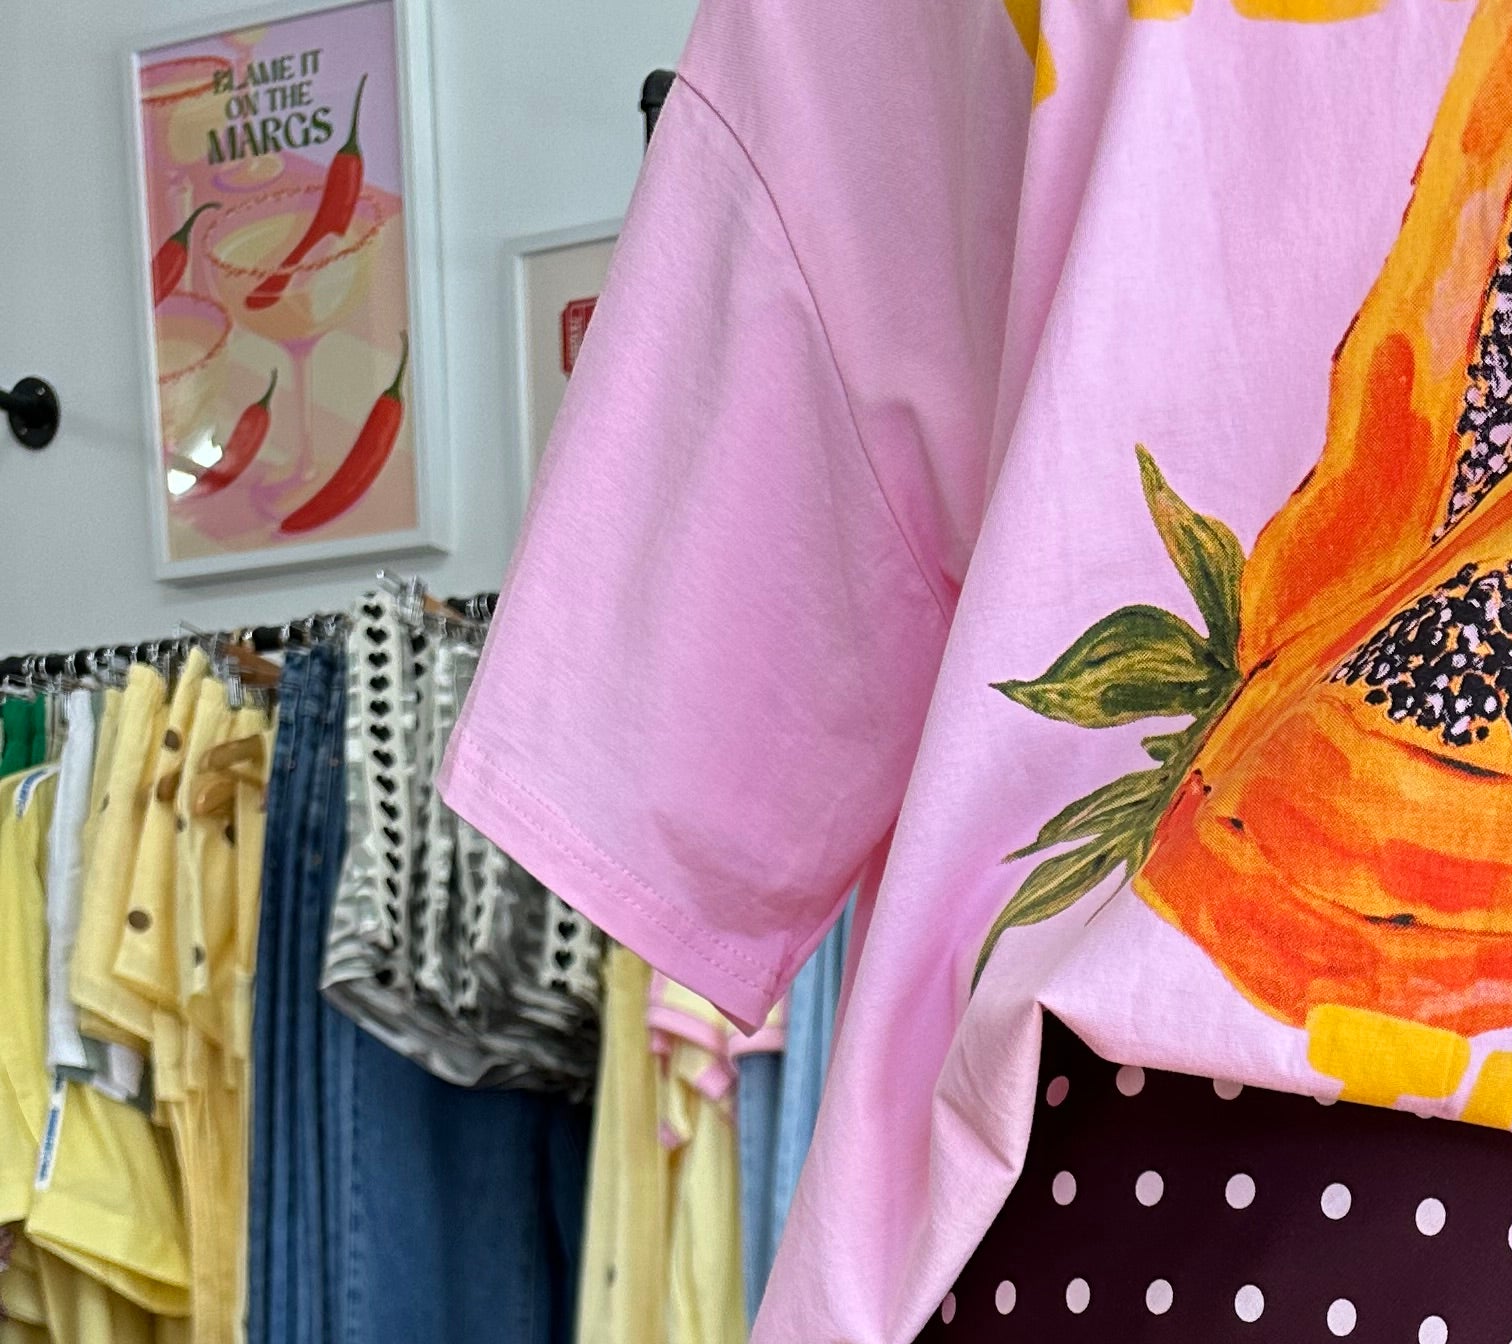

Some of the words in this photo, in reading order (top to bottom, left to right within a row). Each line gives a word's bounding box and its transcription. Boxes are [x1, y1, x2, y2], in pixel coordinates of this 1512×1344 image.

[213, 55, 295, 95] BLAME
[301, 49, 323, 77] IT
[225, 90, 258, 120] ON
[266, 80, 312, 112] THE
[207, 106, 333, 166] MARGS
